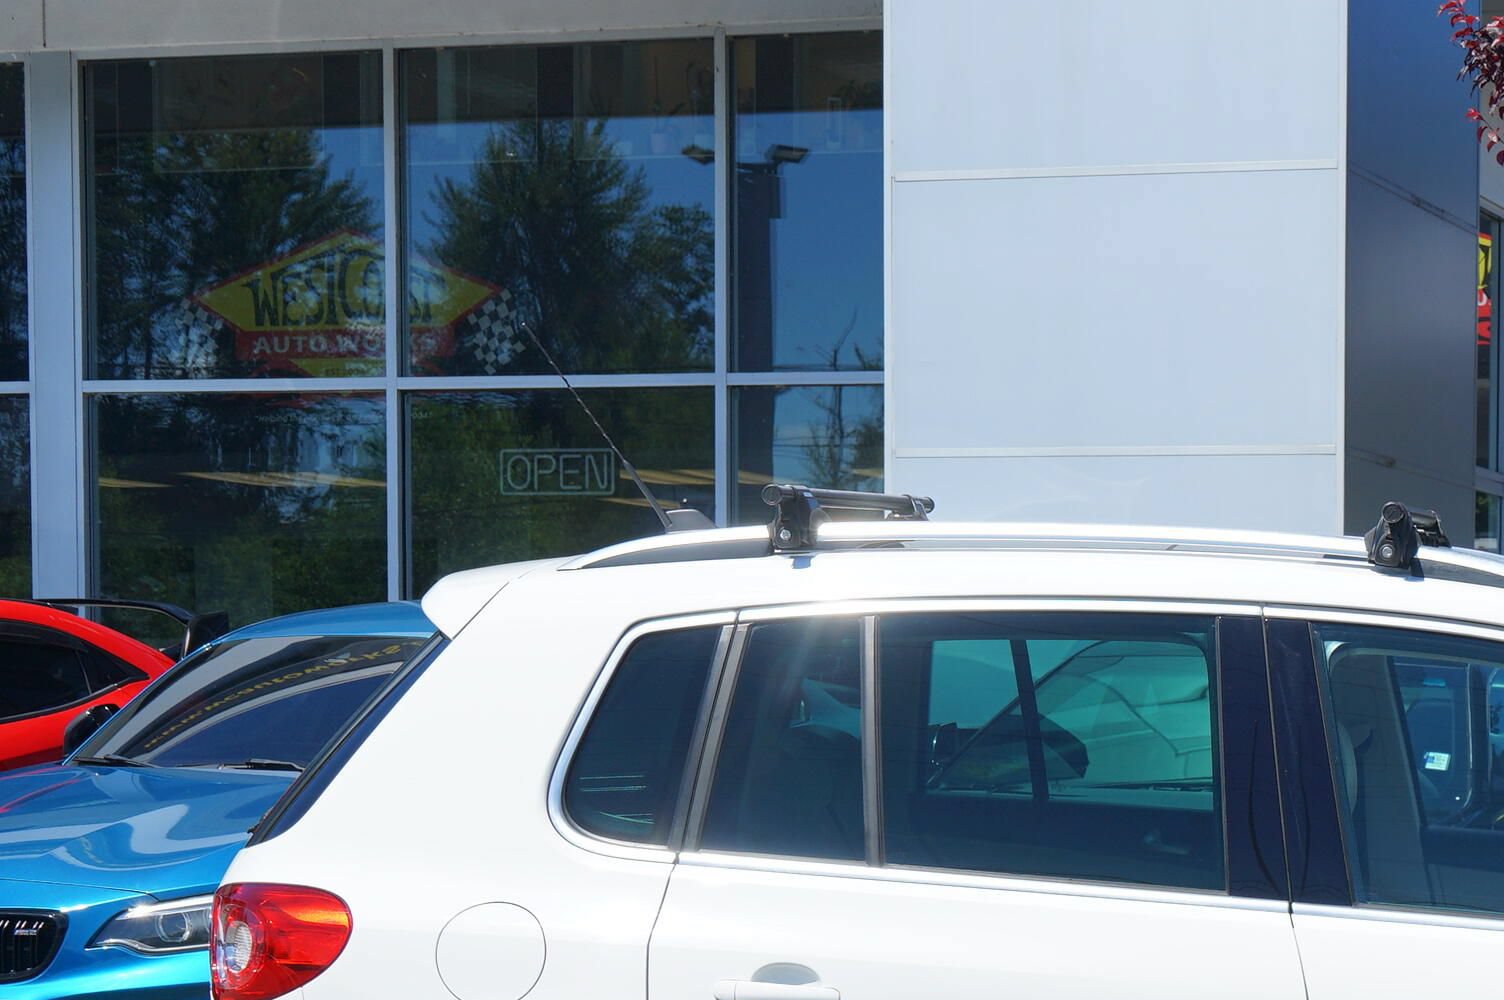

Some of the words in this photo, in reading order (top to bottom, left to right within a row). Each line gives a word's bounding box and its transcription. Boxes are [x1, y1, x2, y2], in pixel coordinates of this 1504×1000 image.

[241, 253, 339, 327] WEST
[337, 249, 447, 323] COST
[255, 335, 328, 353] AUTO
[335, 333, 438, 353] WOS
[507, 454, 608, 490] OPEN
